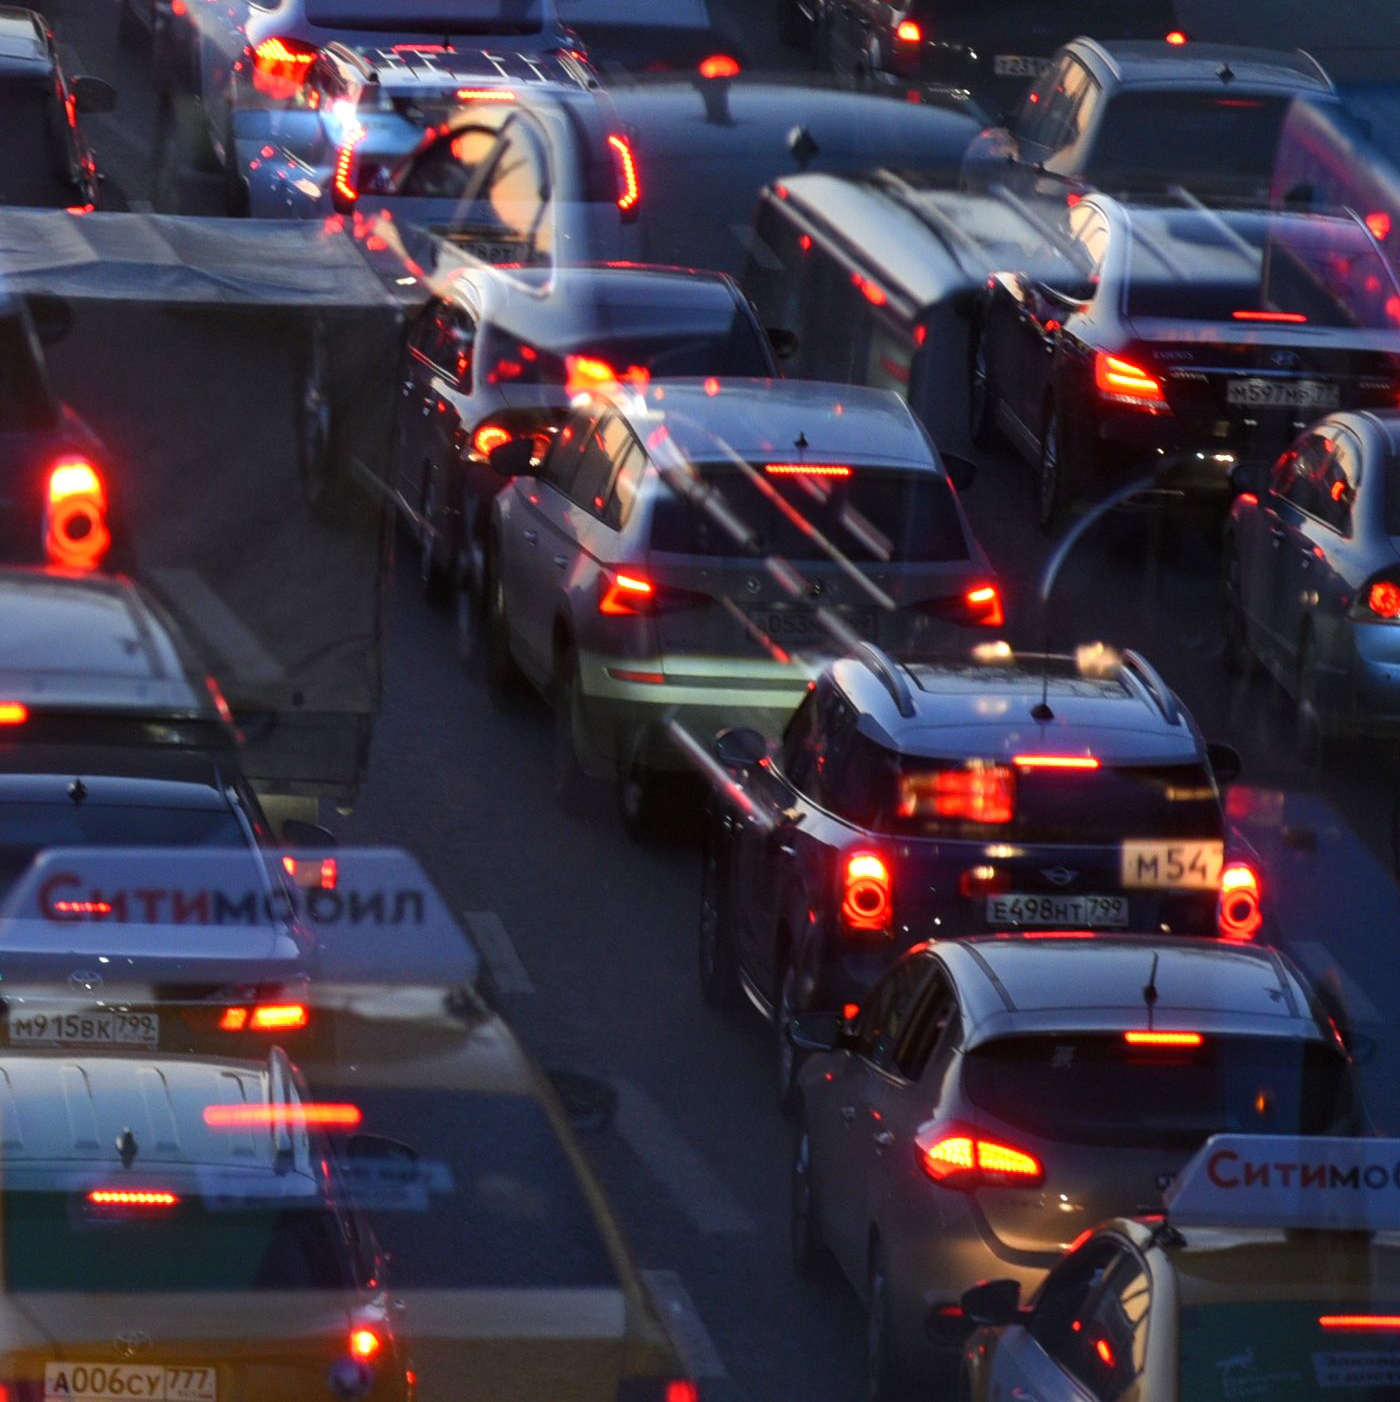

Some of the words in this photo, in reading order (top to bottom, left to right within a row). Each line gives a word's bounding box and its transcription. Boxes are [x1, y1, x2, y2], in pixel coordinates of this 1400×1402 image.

[994, 897, 1082, 920] Е498НТ
[15, 1015, 111, 1039] М915ВК
[53, 1366, 162, 1395] А006СУ
